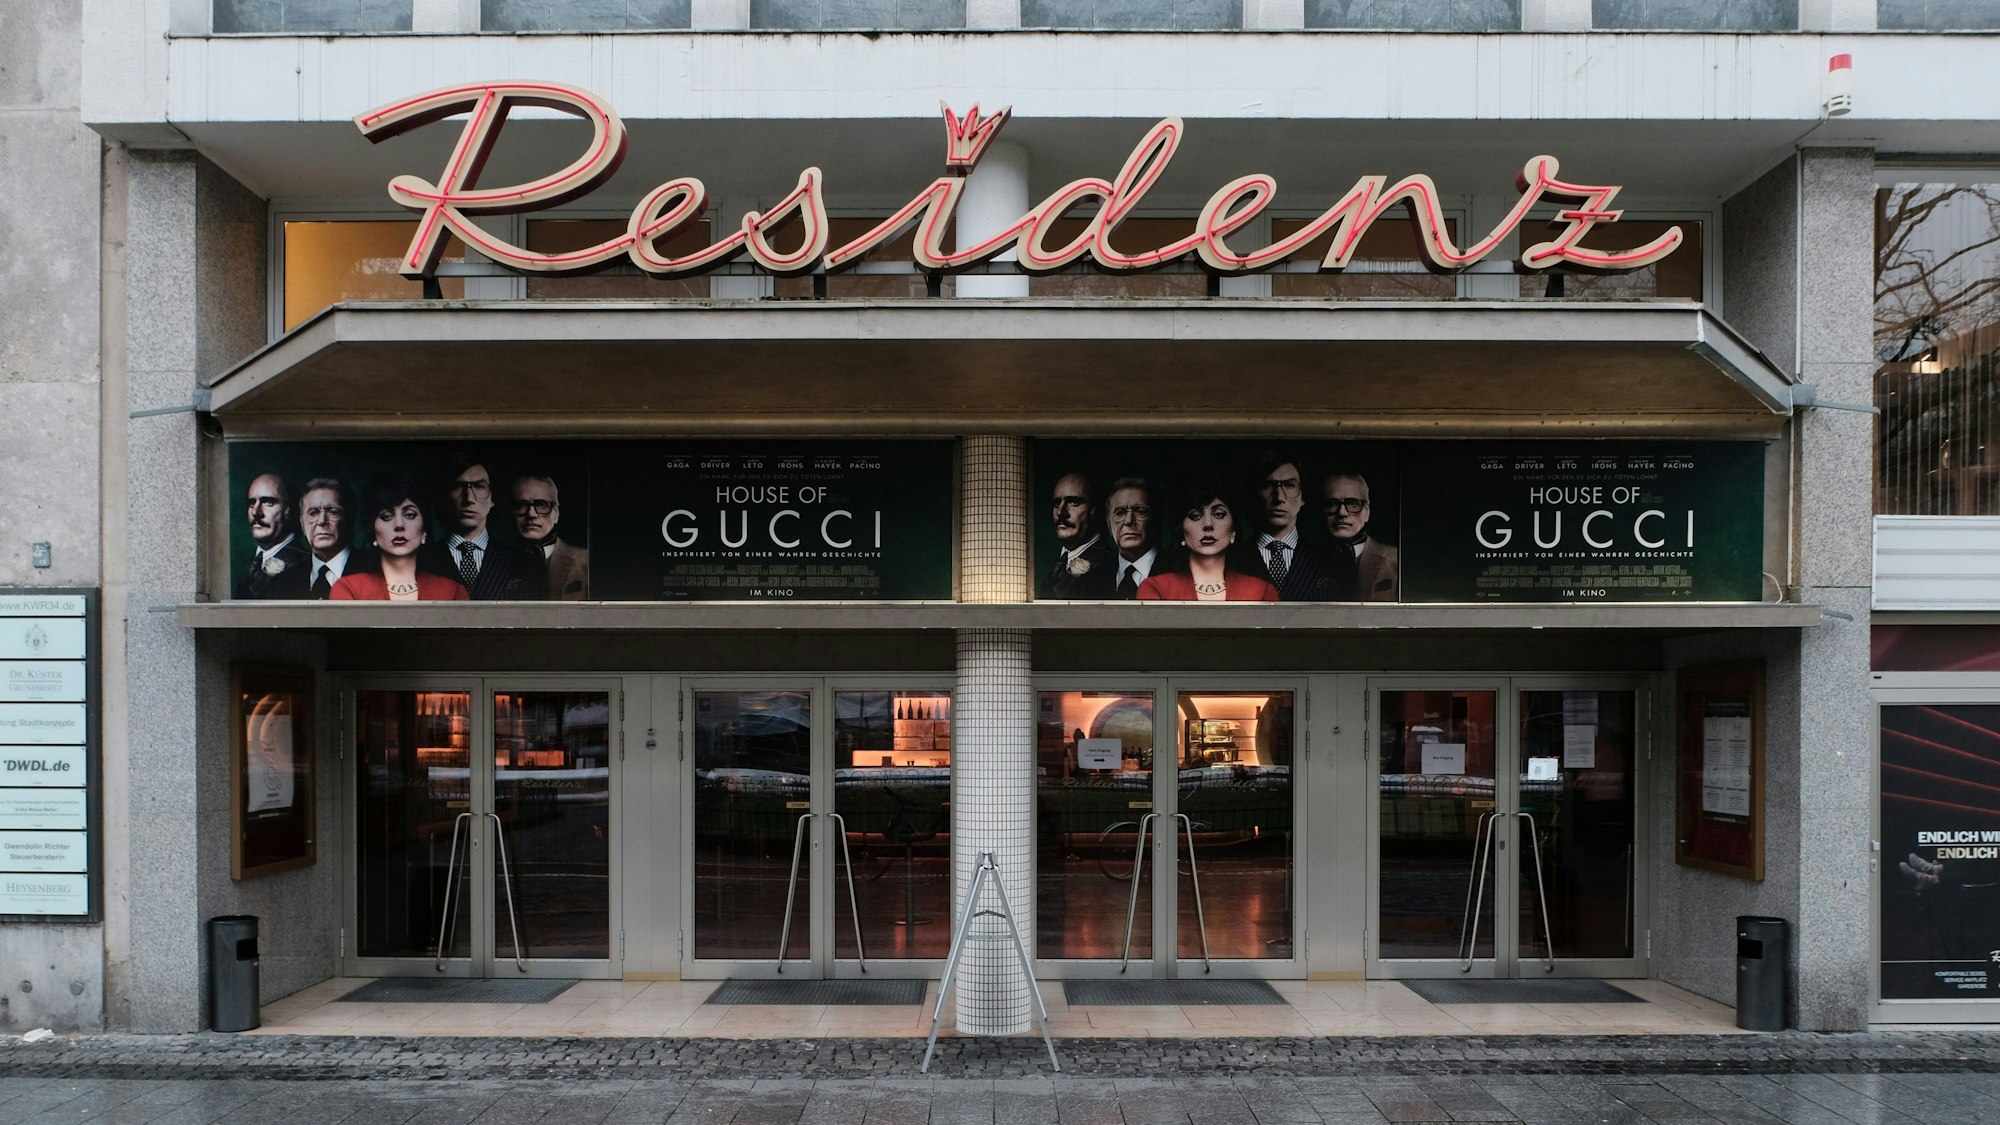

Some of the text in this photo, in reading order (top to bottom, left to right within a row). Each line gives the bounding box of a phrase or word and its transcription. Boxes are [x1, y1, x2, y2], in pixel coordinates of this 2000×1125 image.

[353, 80, 1684, 278] Residenz
[716, 486, 789, 504] HOUSE
[798, 486, 827, 504] OF
[1530, 487, 1603, 504] HOUSE
[1612, 487, 1641, 504] OF
[661, 509, 881, 549] GUCCI
[1475, 509, 1694, 549] GUCCI
[750, 589, 794, 597] IM KINO
[1562, 589, 1607, 597] IM KINO
[0, 601, 75, 611] www.KWR34.de
[27, 669, 64, 680] KÜSTER
[9, 684, 64, 693] GRUNDBESITZ
[19, 719, 76, 728] Stadtkonzepte
[6, 760, 71, 771] DWDL.de
[1917, 831, 2000, 843] ENDLICH WI
[4, 842, 70, 850] Gwendolin Richter
[9, 853, 65, 861] Steuerberaterin
[1937, 847, 1998, 859] ENDLICH
[6, 883, 71, 894] HEYSENBERG
